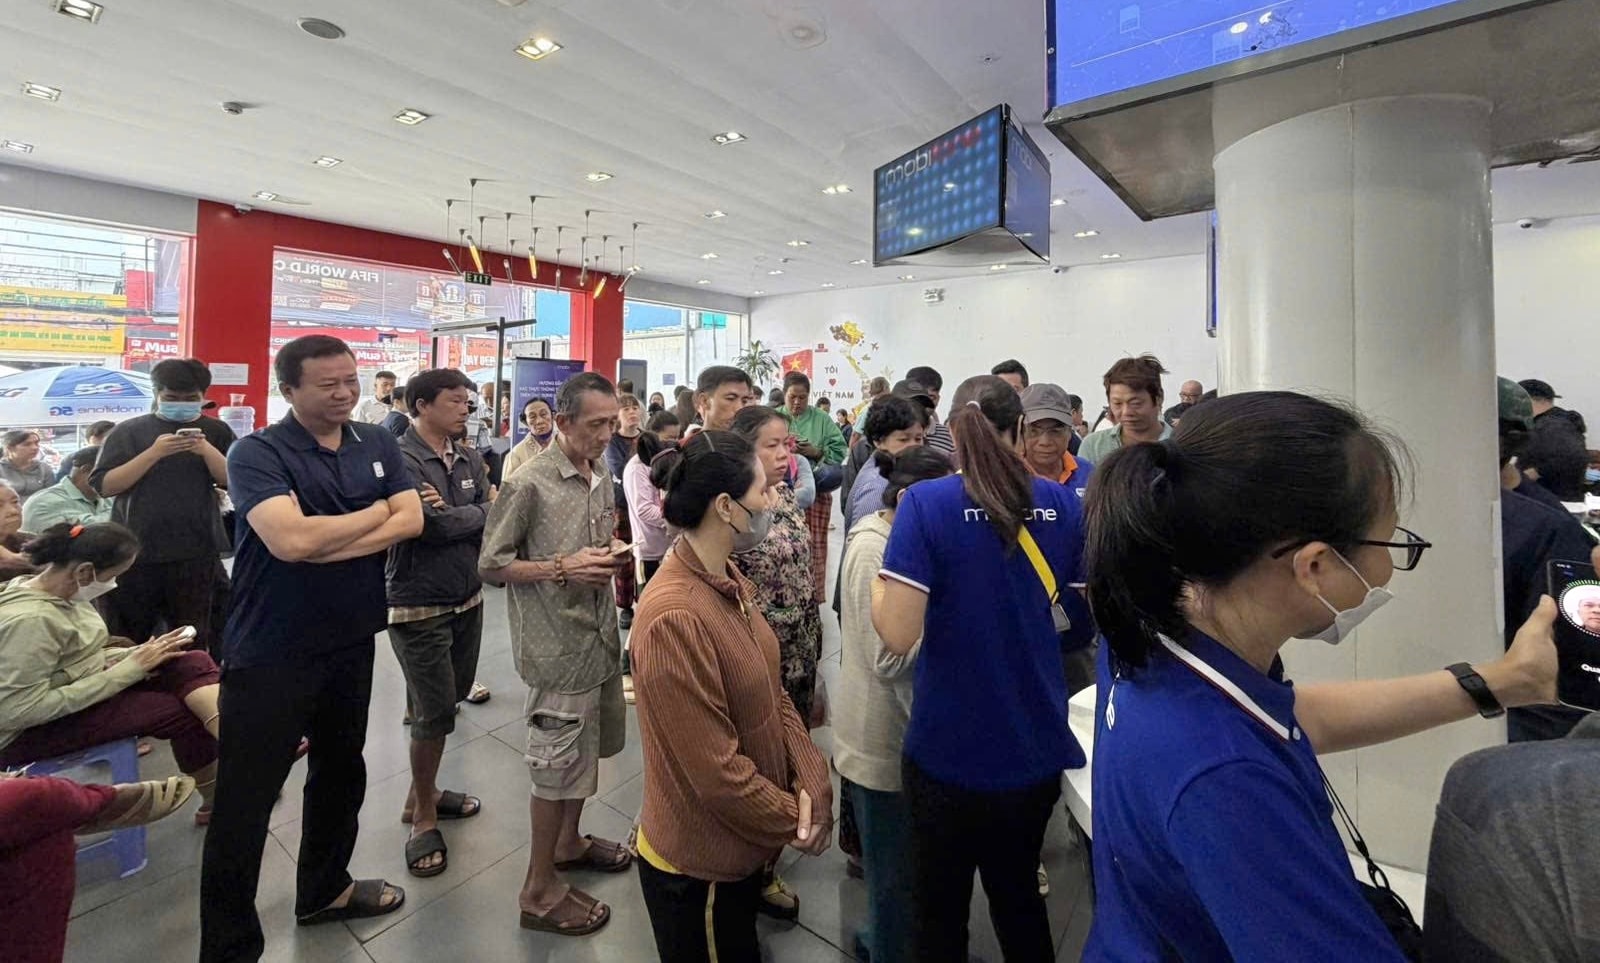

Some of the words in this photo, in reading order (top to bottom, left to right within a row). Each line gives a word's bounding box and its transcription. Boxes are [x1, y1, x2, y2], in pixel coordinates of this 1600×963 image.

[466, 273, 489, 284] EXIT
[824, 365, 839, 374] TÔI
[835, 391, 854, 399] NAM
